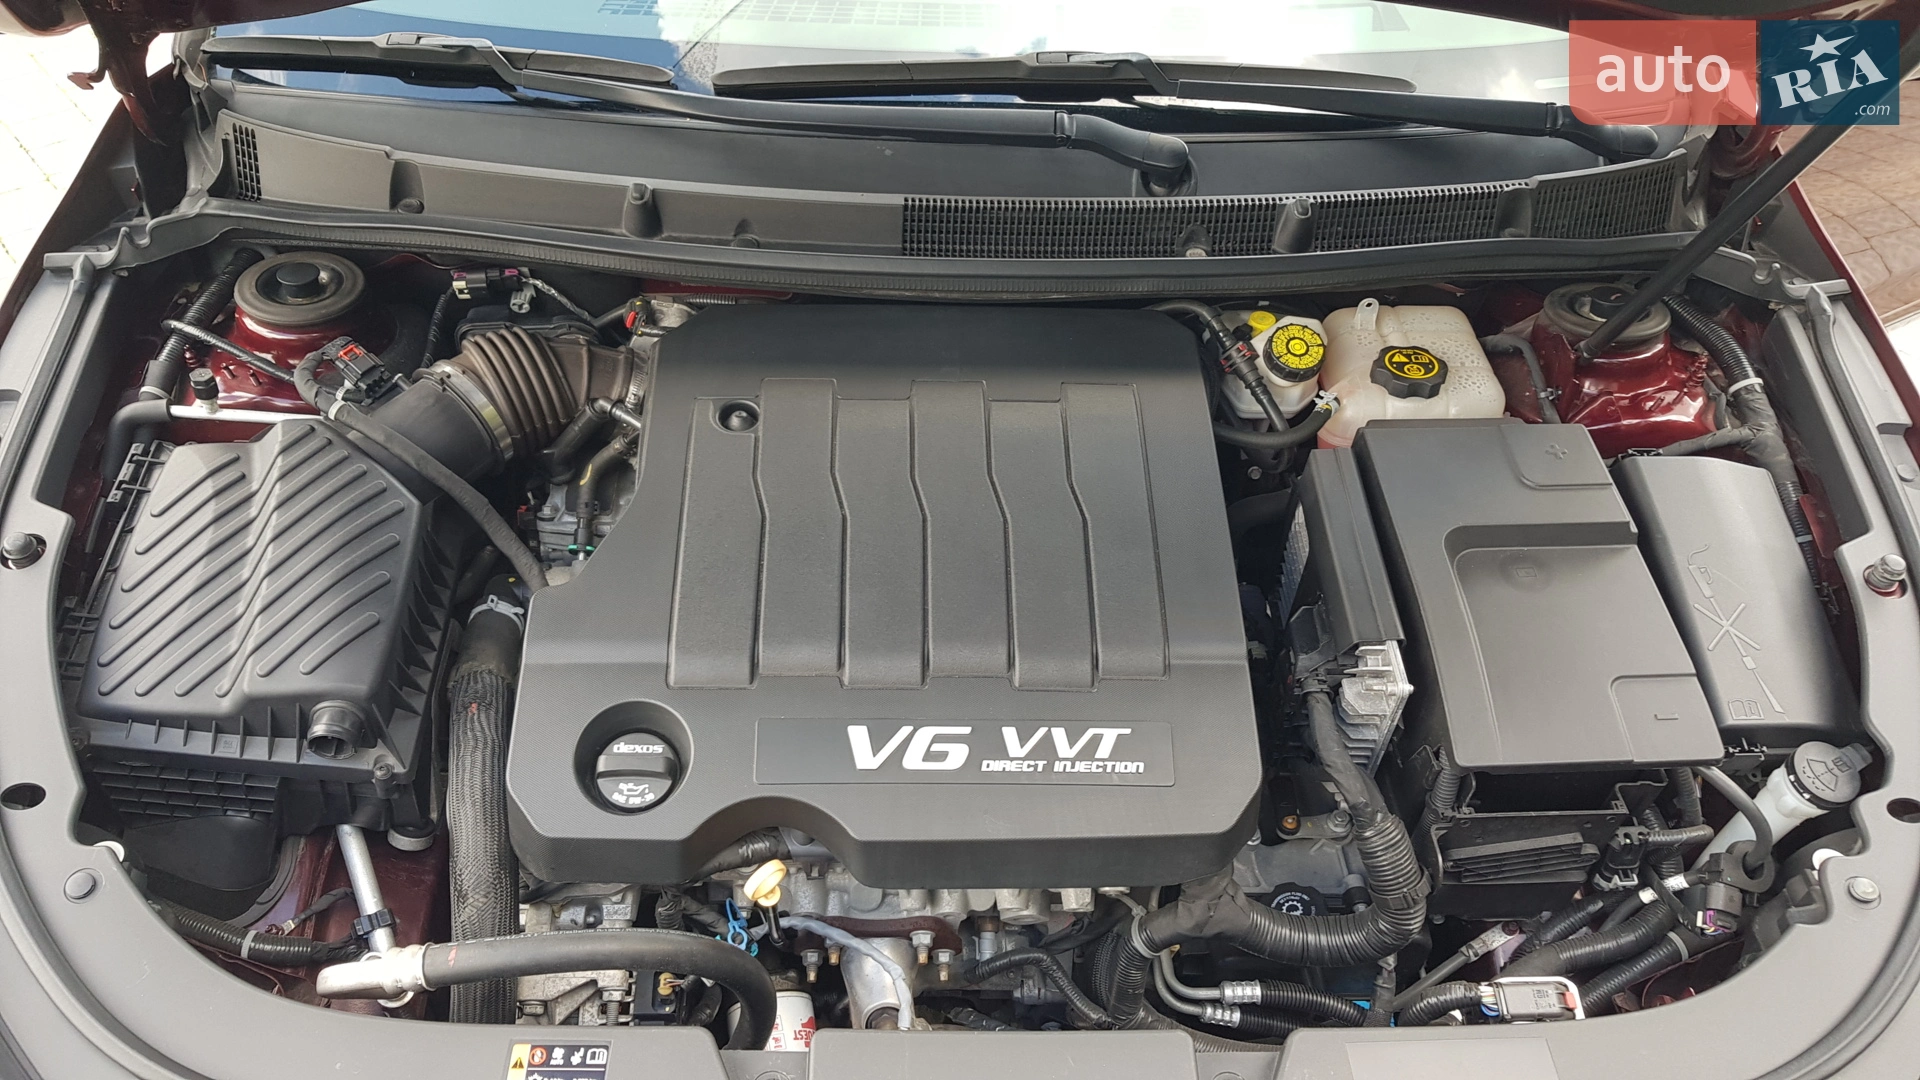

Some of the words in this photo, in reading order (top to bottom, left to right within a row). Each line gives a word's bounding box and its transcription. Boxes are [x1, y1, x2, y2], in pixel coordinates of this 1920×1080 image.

[613, 742, 665, 753] dexos
[847, 725, 973, 771] V6
[1001, 726, 1132, 759] VVT
[981, 759, 1047, 772] DIRECT
[1054, 759, 1145, 774] INJECTION
